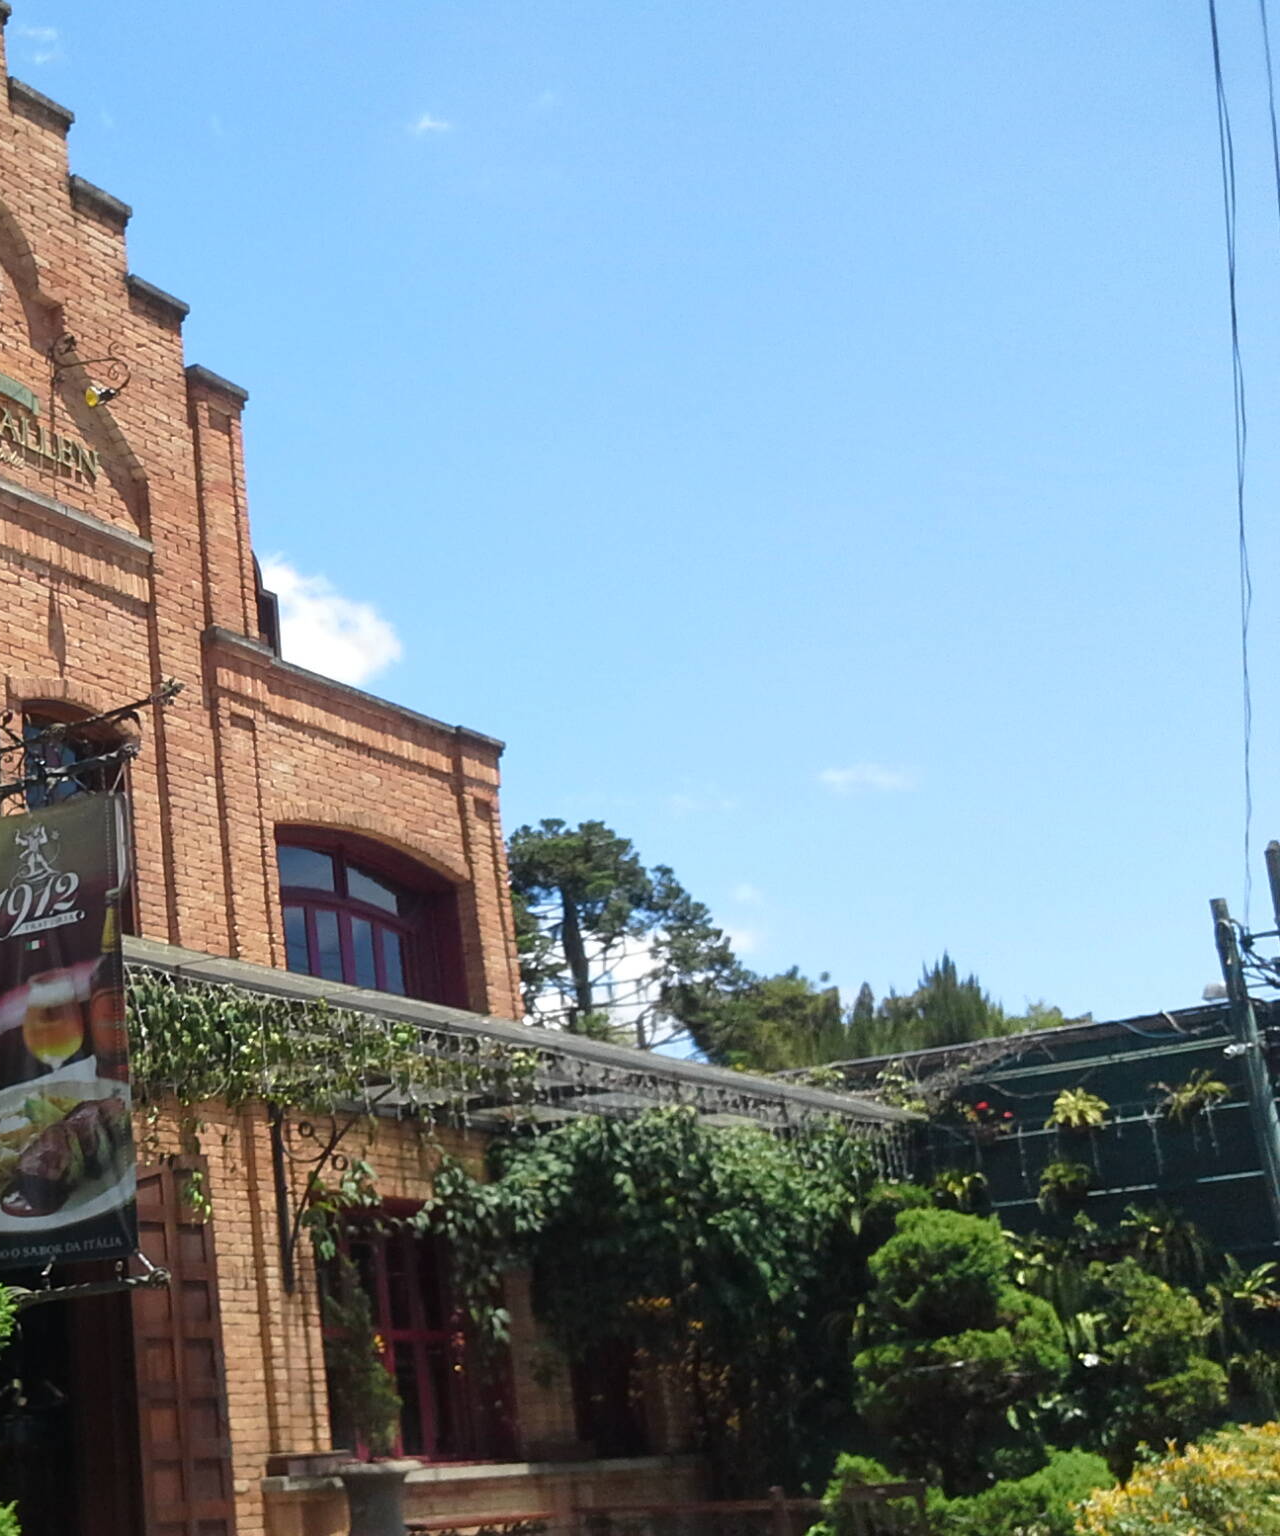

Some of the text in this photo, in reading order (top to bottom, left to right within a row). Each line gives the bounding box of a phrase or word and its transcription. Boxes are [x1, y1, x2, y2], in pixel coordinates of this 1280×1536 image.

[23, 1245, 61, 1257] SABOR
[65, 1242, 81, 1253] DA
[83, 1236, 123, 1250] ITÁLIA
